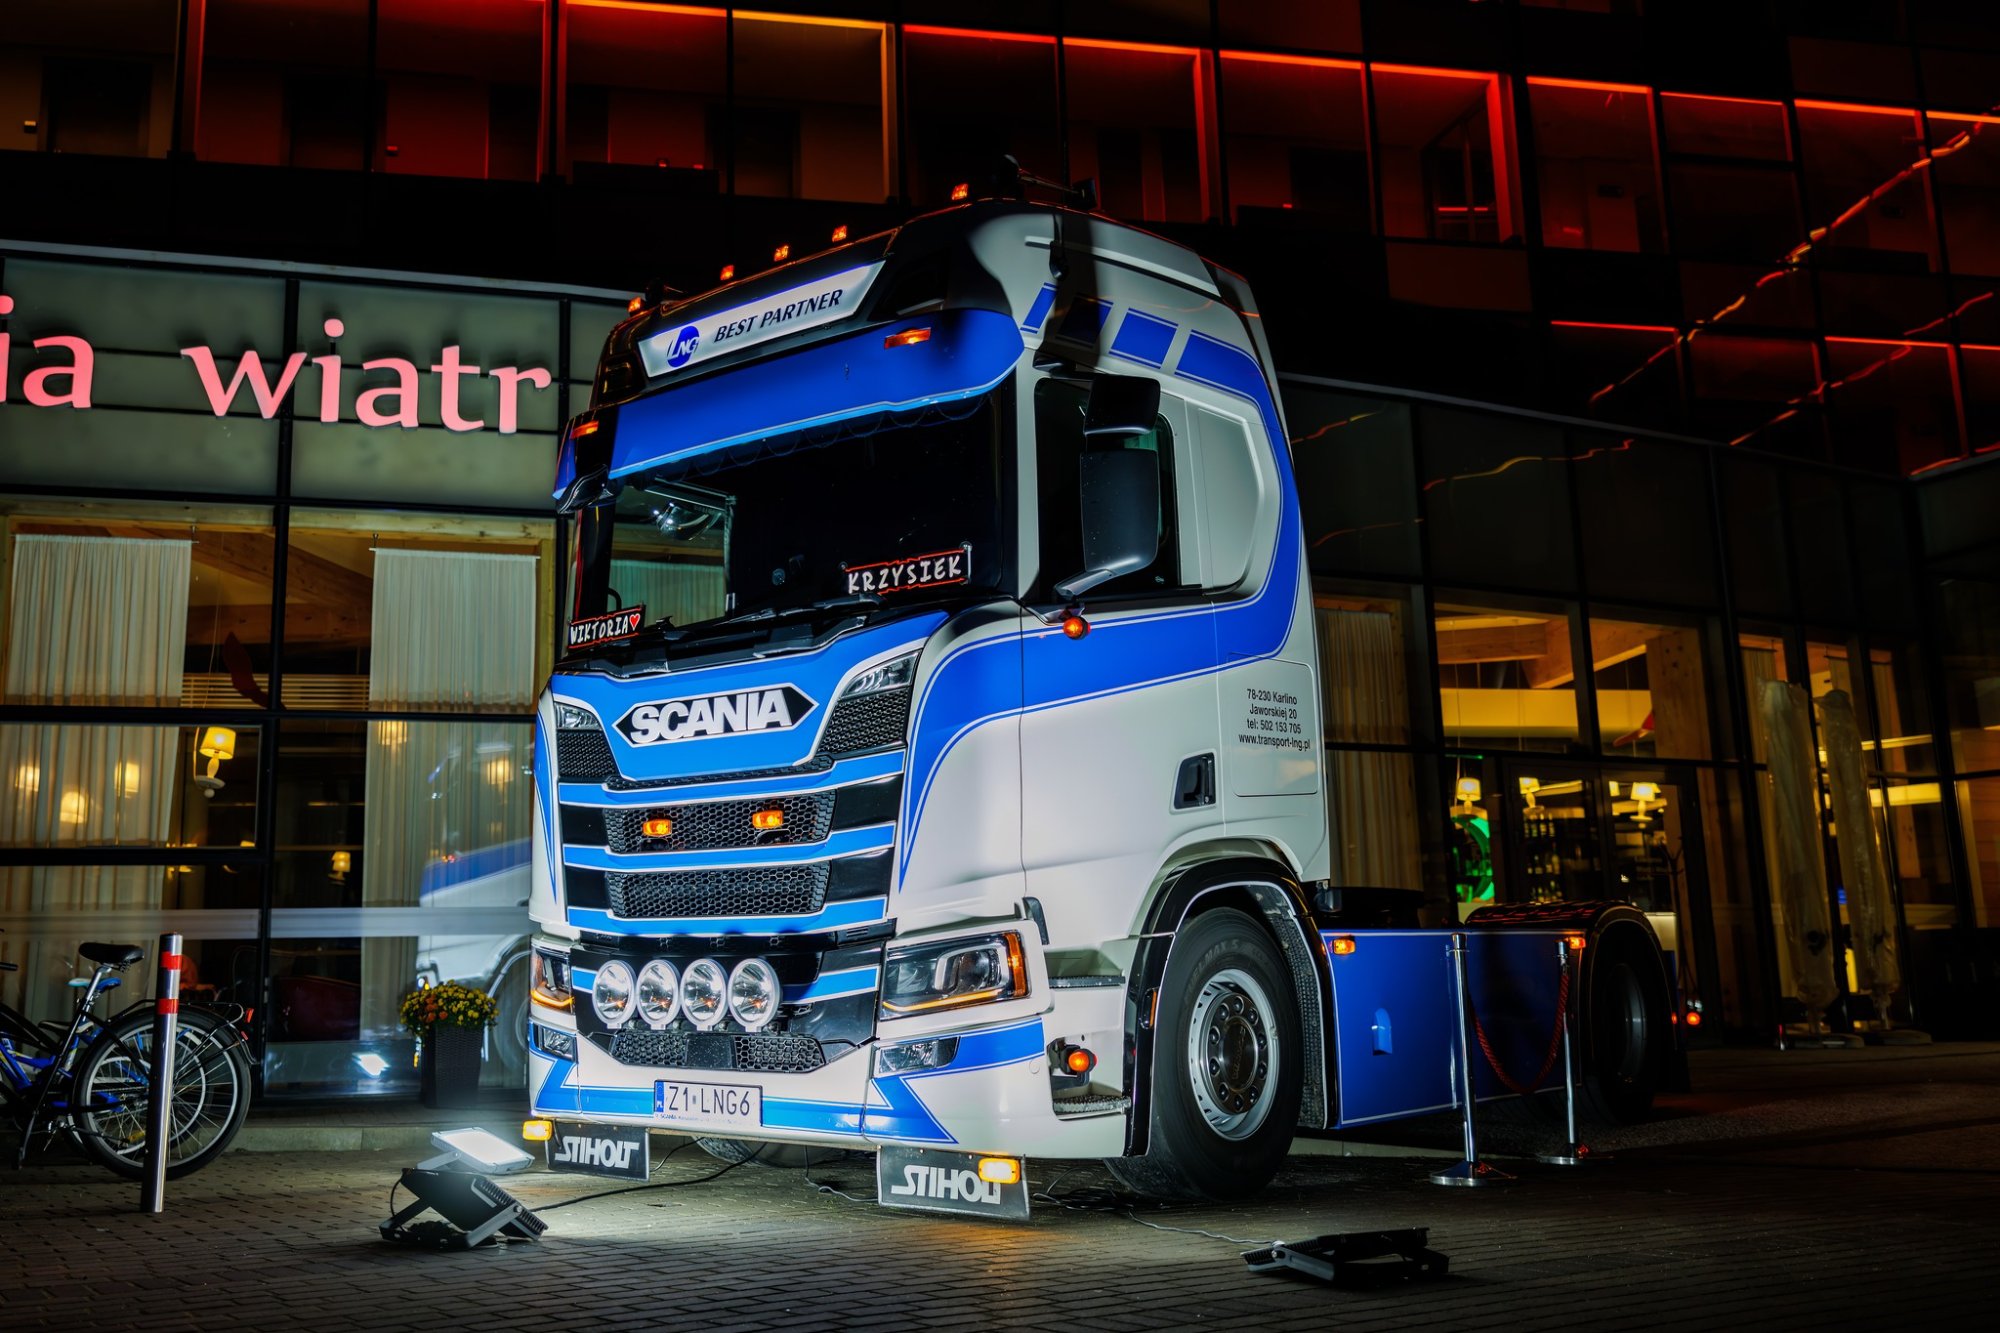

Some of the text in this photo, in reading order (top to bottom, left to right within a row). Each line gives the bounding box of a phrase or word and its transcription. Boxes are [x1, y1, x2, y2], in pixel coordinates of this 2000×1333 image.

[713, 289, 843, 343] BEST PARTNER
[180, 318, 552, 434] wiatr
[848, 555, 961, 594] KRZYSIEK
[570, 615, 628, 645] WIKTORIA
[1247, 688, 1297, 705] 78-230 Karlino
[1250, 703, 1297, 720] Jaworskiej 20
[630, 689, 792, 743] SCANIA
[1247, 719, 1301, 734] tel: 502 153 705
[1239, 734, 1310, 751] www.transport-lng.pl
[669, 1086, 750, 1116] Z1 LNG6
[891, 1164, 1001, 1205] STIHOL
